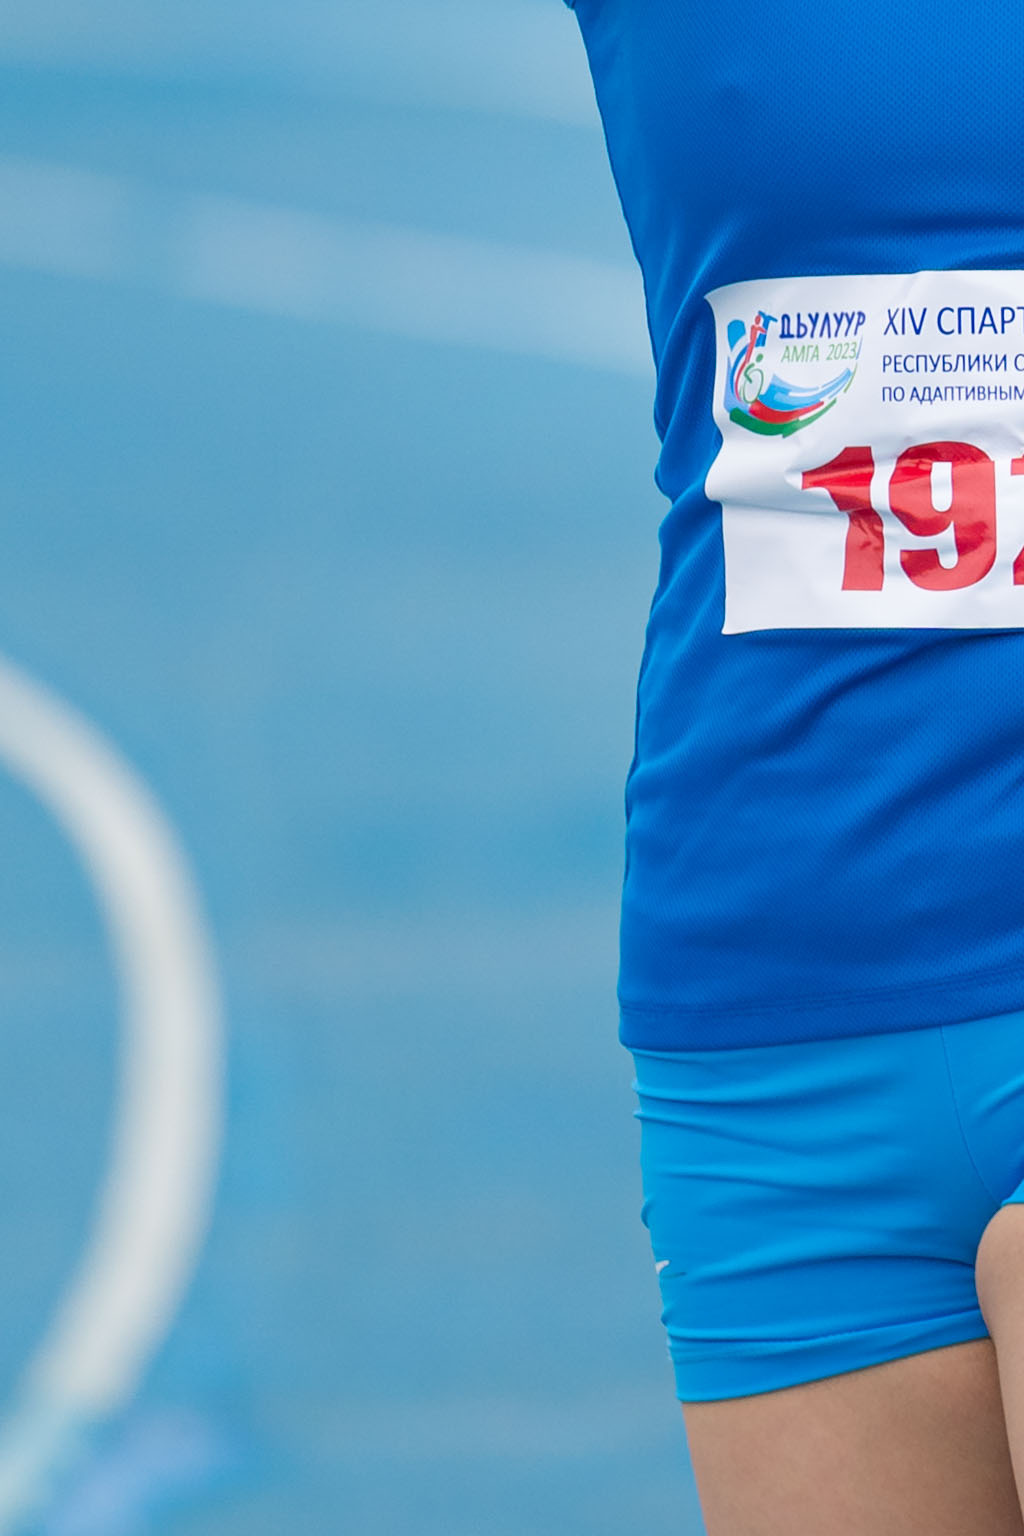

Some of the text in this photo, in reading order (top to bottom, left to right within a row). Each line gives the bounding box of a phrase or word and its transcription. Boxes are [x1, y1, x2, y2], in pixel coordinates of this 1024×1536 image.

[883, 307, 927, 335] XIV
[780, 342, 857, 363] АМГА 2023
[882, 353, 1007, 373] РЕСПУБЛИКИ
[881, 385, 905, 402] ПО
